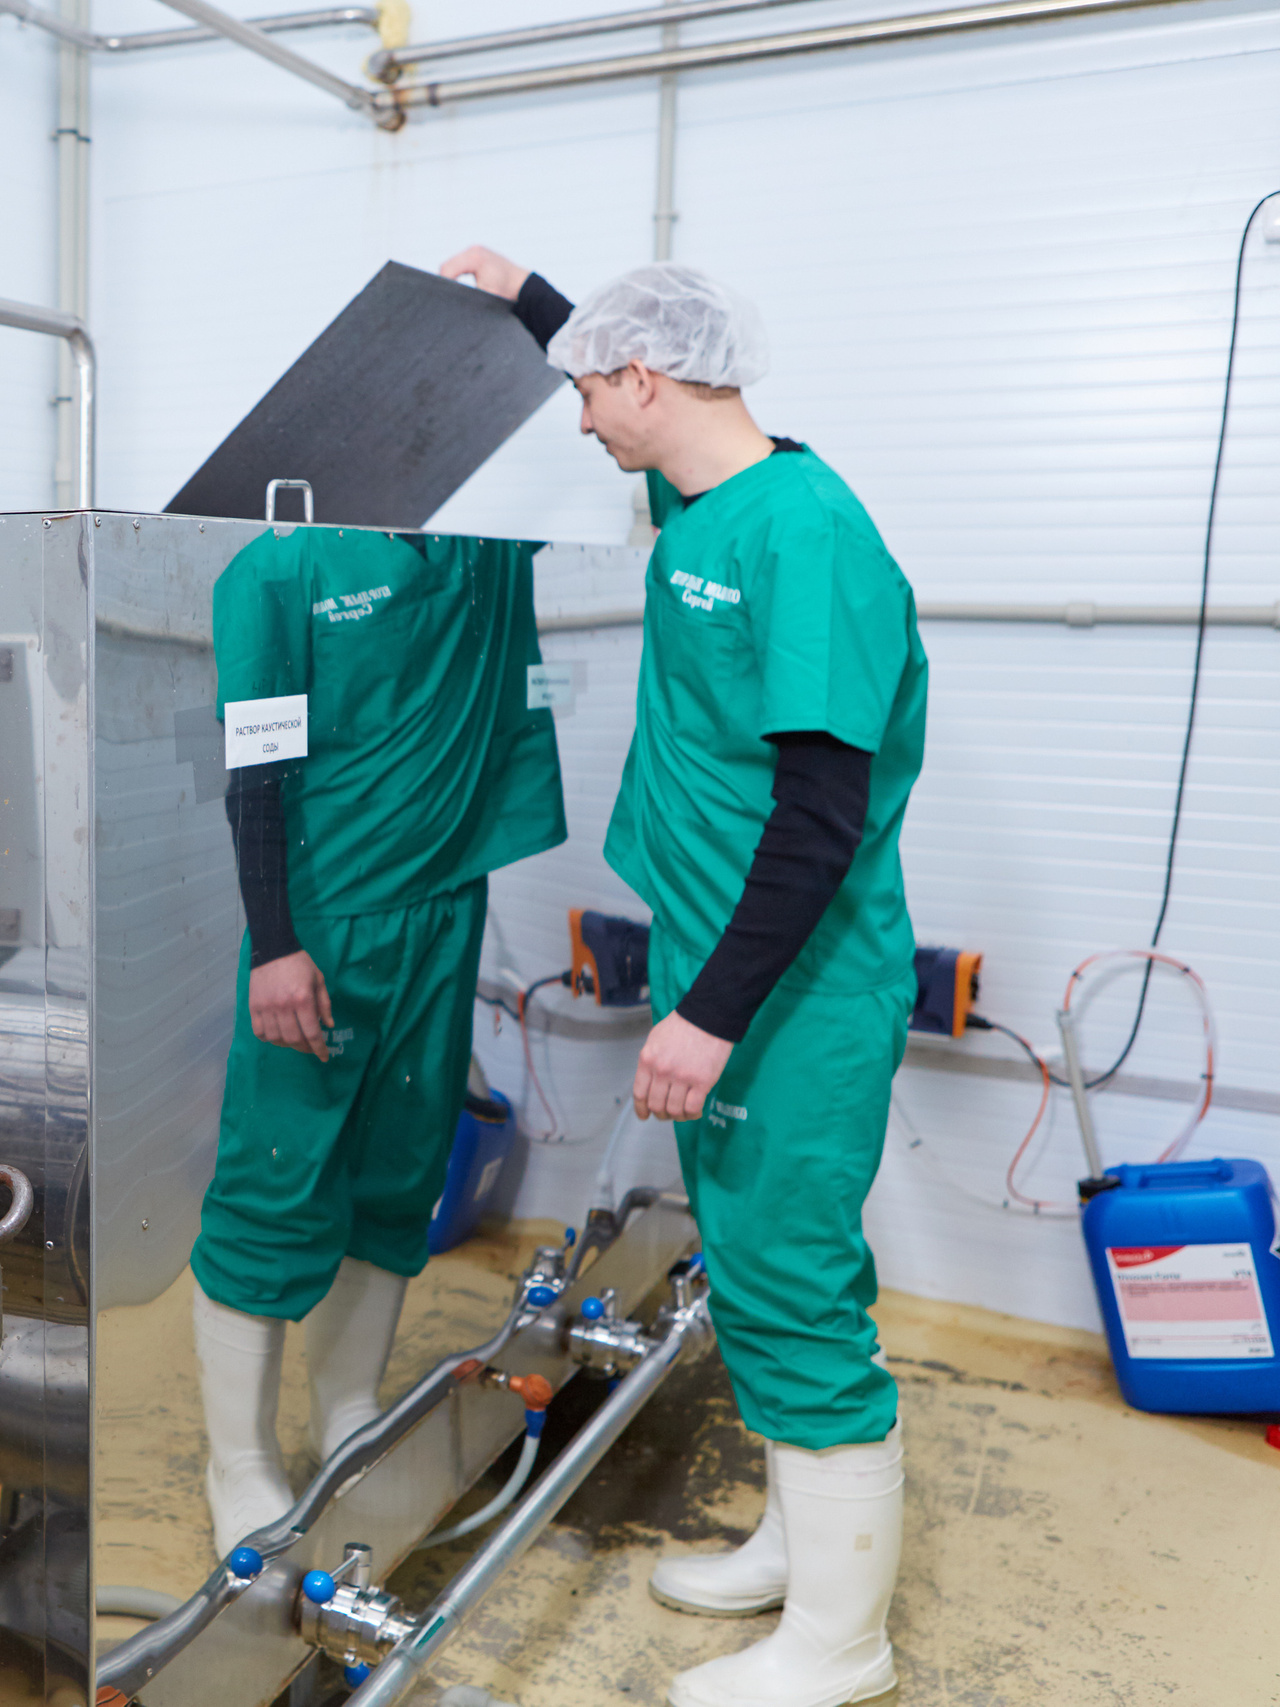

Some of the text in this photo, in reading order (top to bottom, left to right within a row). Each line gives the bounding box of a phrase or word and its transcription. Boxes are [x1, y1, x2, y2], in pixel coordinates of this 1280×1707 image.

[235, 717, 301, 737] РАСТВОР КАУСТИЧЕСКОЙ
[262, 742, 279, 754] СОДЫ
